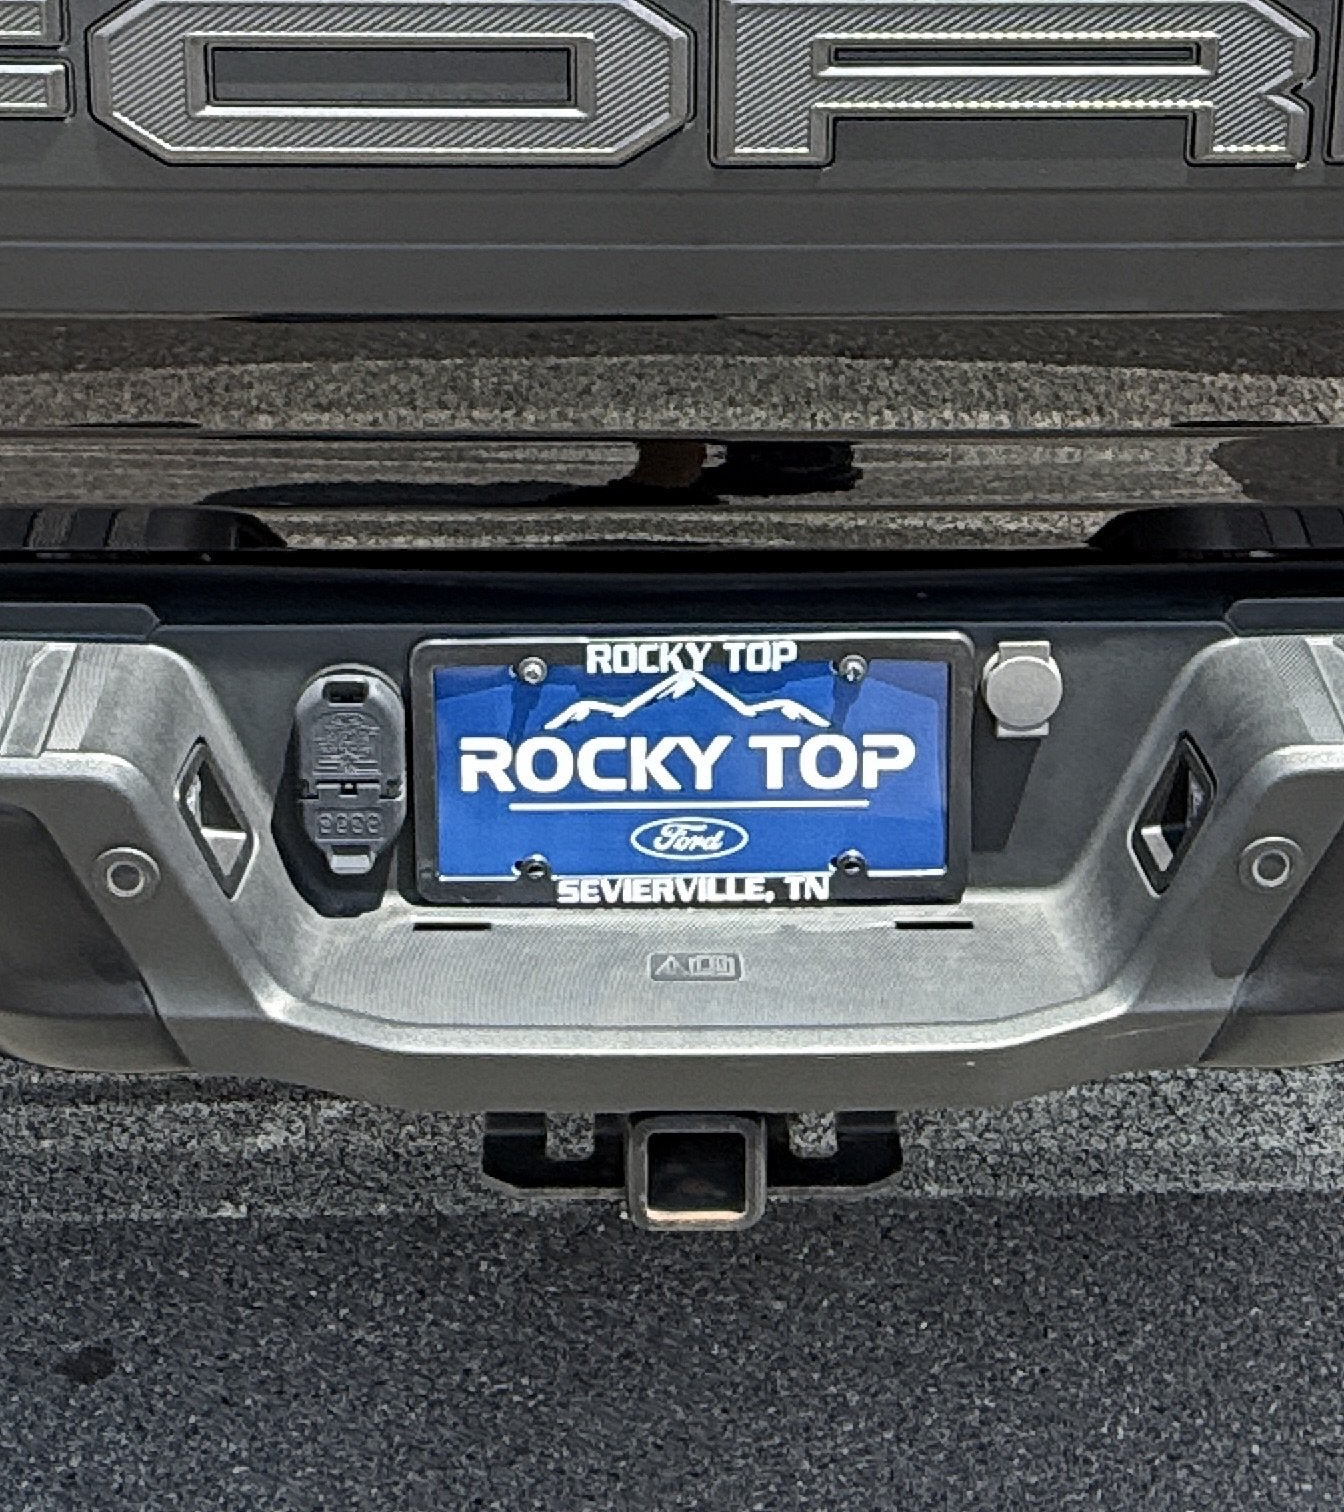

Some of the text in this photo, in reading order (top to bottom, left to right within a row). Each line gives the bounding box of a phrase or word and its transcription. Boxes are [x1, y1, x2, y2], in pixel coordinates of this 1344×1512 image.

[586, 640, 799, 675] ROCKY TOP
[458, 733, 917, 793] ROCKY TOP
[652, 821, 725, 852] Ford
[556, 875, 831, 905] SEVIERVILLE, TN
